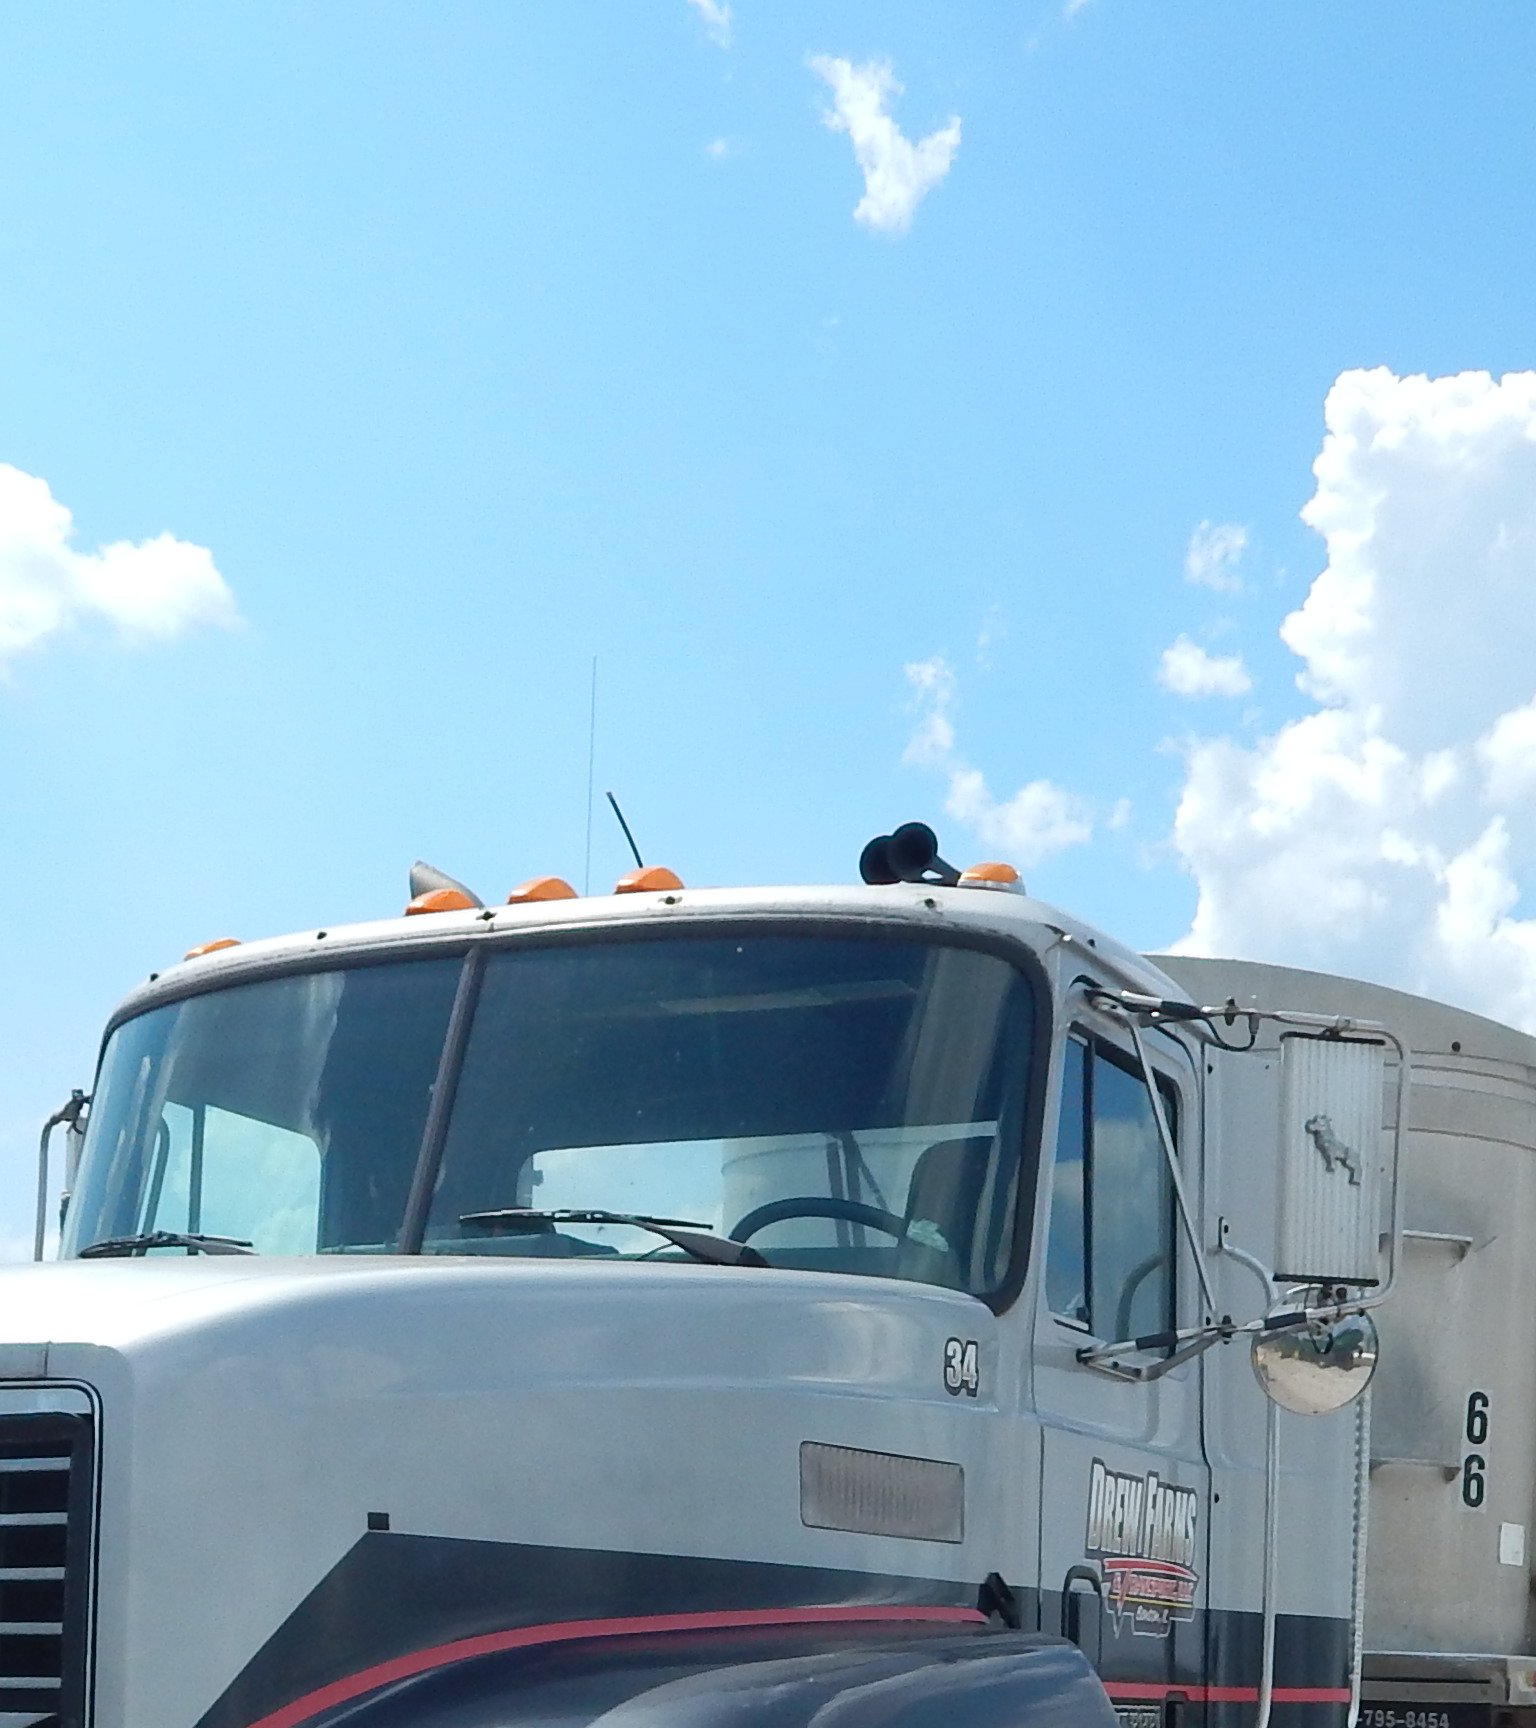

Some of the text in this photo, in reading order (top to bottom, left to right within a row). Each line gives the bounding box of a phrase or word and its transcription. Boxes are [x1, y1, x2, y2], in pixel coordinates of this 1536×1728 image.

[944, 1337, 979, 1396] 34
[1086, 1460, 1196, 1567] DREW FARMS
